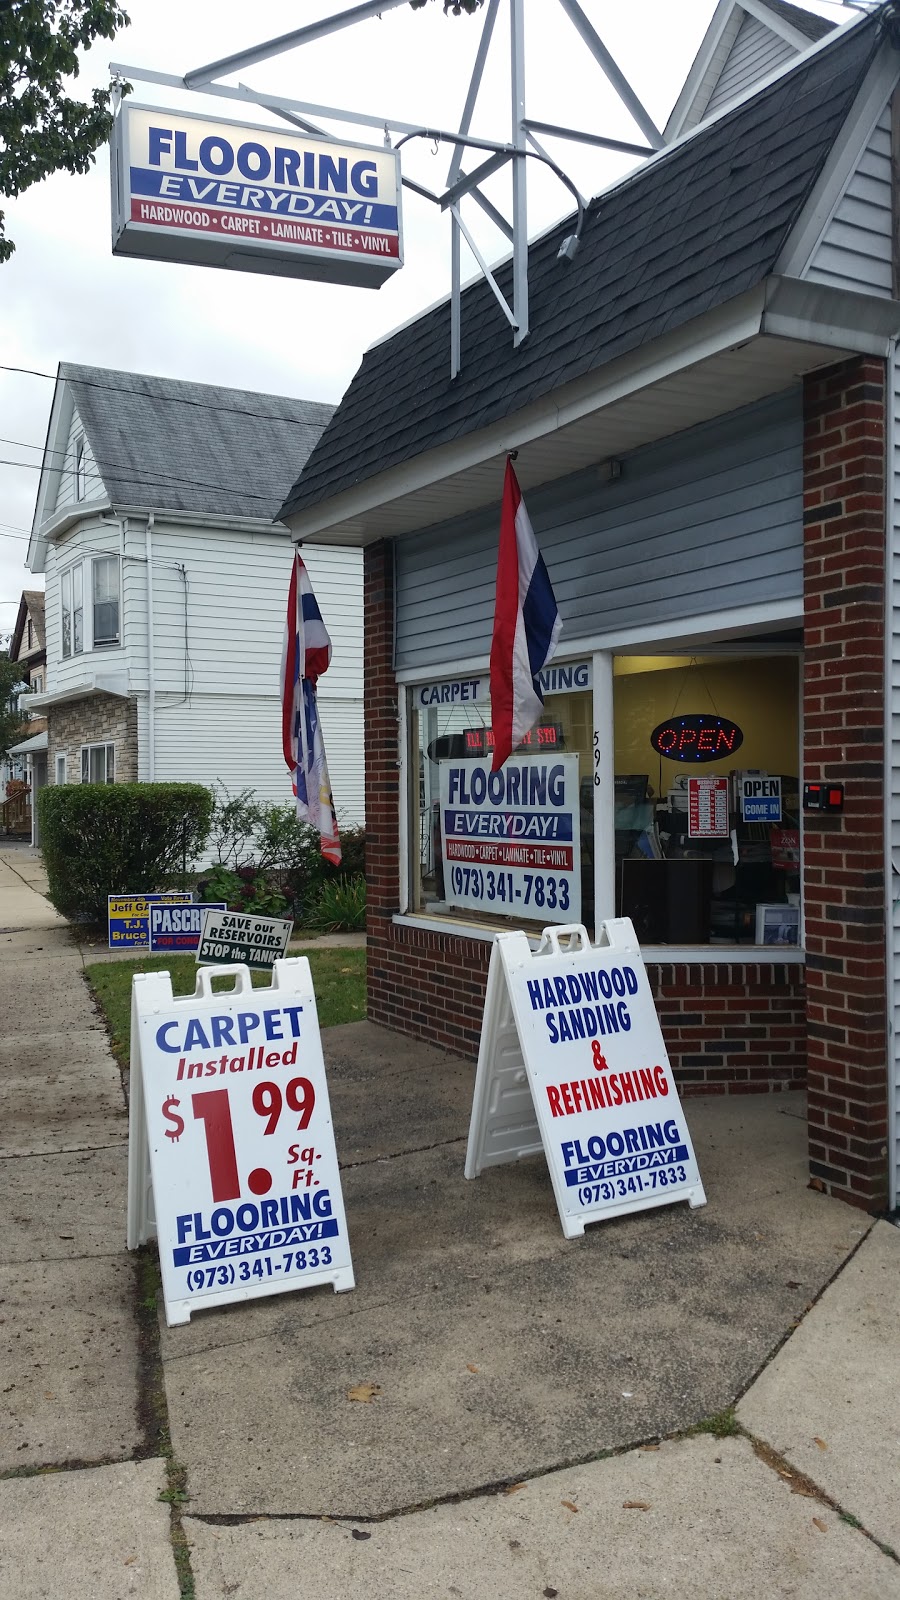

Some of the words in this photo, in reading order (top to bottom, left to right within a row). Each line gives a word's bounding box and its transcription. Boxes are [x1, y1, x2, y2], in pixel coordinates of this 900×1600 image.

[148, 126, 379, 198] FLOORING
[158, 175, 374, 224] EVERYDAY!
[140, 203, 210, 227] HARDWOOD
[220, 215, 261, 235] CARPET
[270, 224, 323, 243] LAMINATE
[331, 231, 353, 248] TILE
[360, 234, 391, 253] VINYL
[420, 680, 481, 706] CARPET
[539, 664, 589, 692] NING
[657, 729, 736, 750] OPEN
[592, 731, 601, 787] 596
[448, 764, 566, 807] FLOORING
[743, 780, 780, 798] OPEN
[453, 813, 559, 838] EVERYDAY!
[744, 805, 769, 816] COME
[770, 804, 780, 815] IN
[448, 842, 475, 859] HARDWOOD
[479, 846, 499, 861] CARPET
[502, 847, 530, 863] LAMINATE
[534, 849, 546, 865] TILE
[550, 850, 568, 866] VINYL
[112, 903, 133, 911] Jeff
[112, 931, 147, 940] Bruce
[123, 920, 144, 928] T.J.
[209, 927, 282, 947] RESERVOIRS
[221, 916, 252, 930] SAVE
[254, 923, 276, 934] our
[157, 937, 174, 945] FOR
[201, 942, 230, 958] STOP
[231, 947, 247, 960] the
[248, 948, 282, 963] TANKS
[526, 966, 638, 1011] HARDWOOD
[156, 1006, 304, 1053] CARPET
[545, 1001, 631, 1044] SANDING
[176, 1042, 298, 1081] Installed
[591, 1039, 609, 1071] &
[546, 1065, 669, 1118] REFINISHING
[287, 1144, 322, 1166] Sq.
[560, 1119, 680, 1167] FLOORING
[291, 1169, 320, 1190] Ft.
[576, 1149, 678, 1183] EVERYDAY!
[176, 1189, 332, 1244] FLOORING
[188, 1223, 324, 1264] EVERYDAY!
